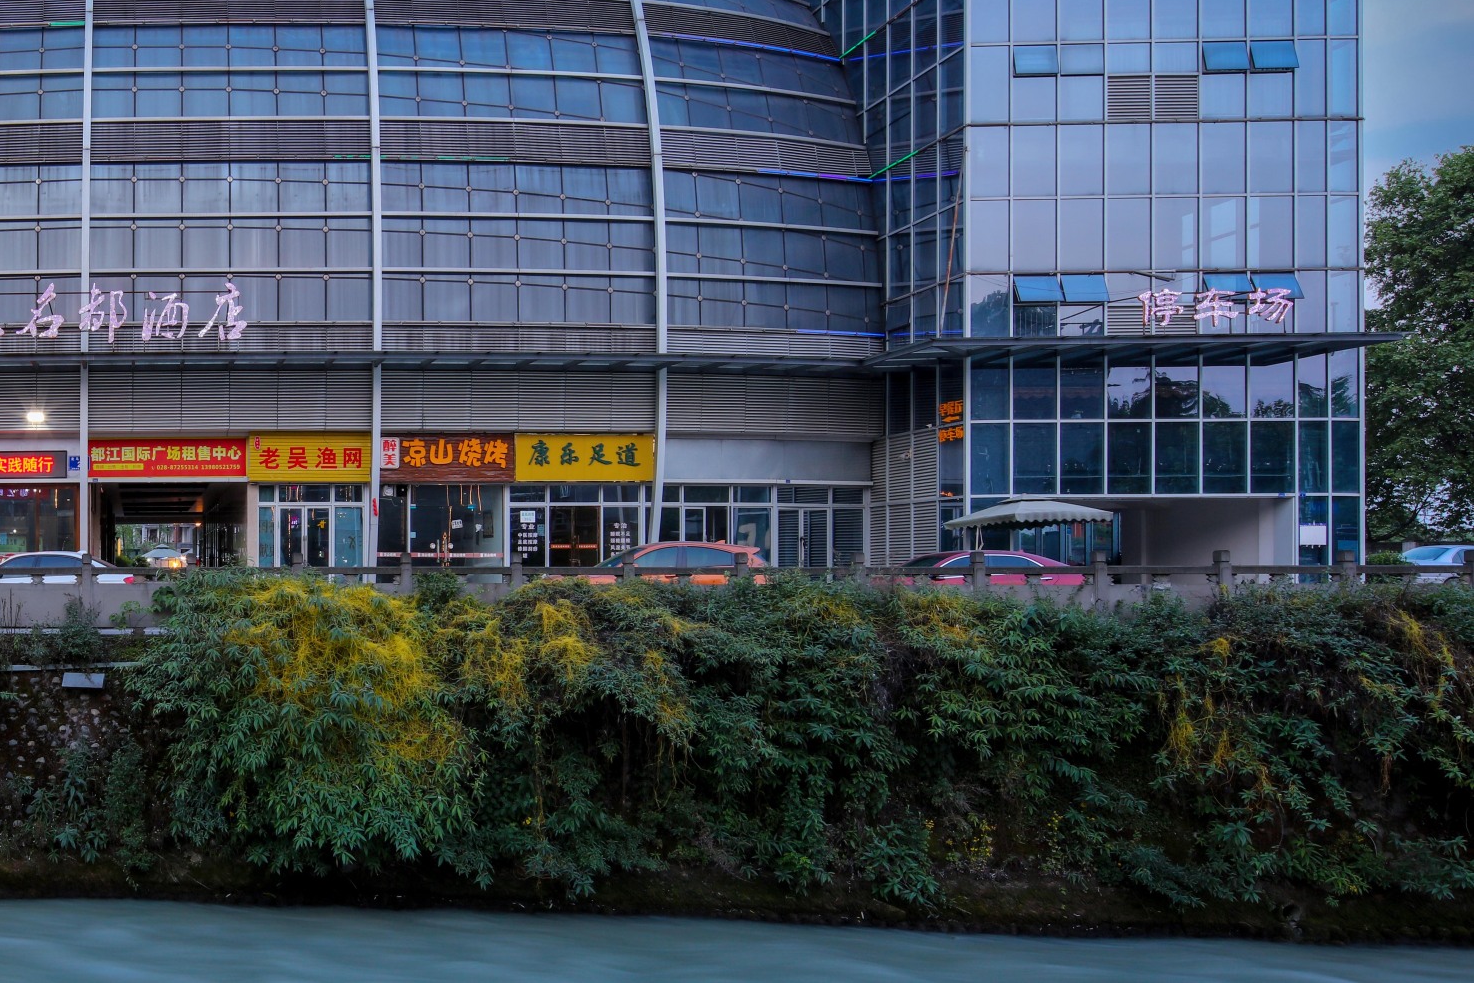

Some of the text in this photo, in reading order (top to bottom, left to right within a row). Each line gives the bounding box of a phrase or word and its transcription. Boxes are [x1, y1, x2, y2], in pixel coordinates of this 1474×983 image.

[1137, 287, 1294, 327] 停车场
[90, 446, 242, 462] 都江国际广场租售中心
[259, 446, 363, 469] 老吴渔网
[382, 439, 398, 466] 醉美
[402, 438, 508, 468] 凉山烧烤
[528, 439, 641, 467] 康乐足道
